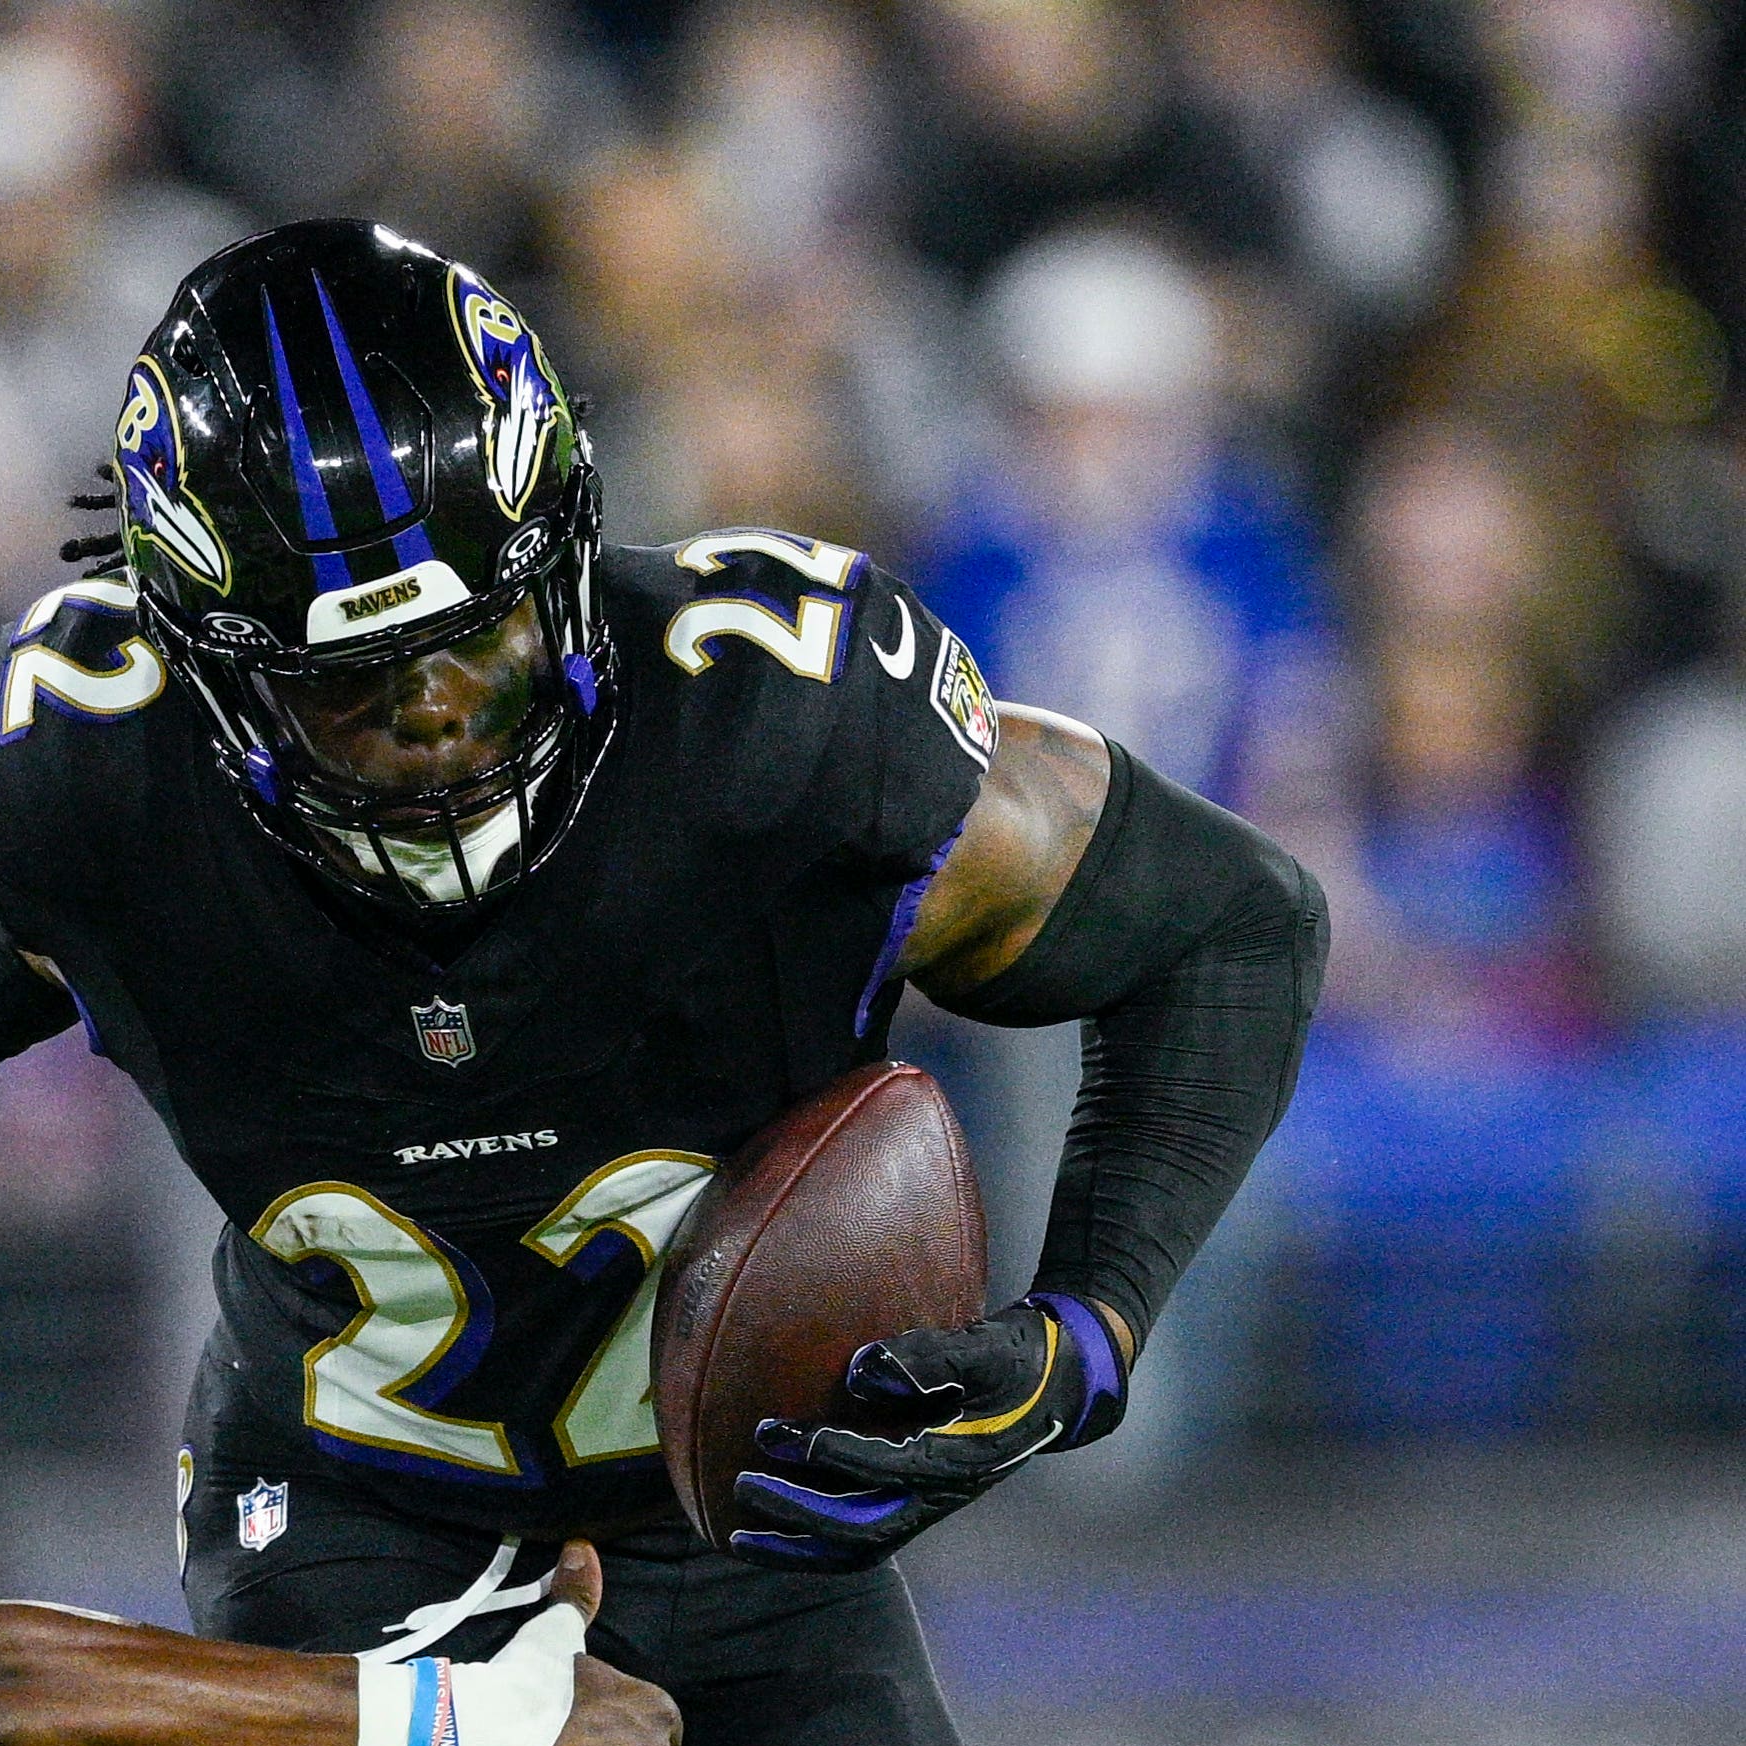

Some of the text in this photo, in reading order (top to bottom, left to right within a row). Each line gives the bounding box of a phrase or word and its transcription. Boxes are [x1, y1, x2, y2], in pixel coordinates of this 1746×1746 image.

[502, 532, 549, 580] OAKLEY
[339, 577, 422, 622] RAVENS
[663, 527, 869, 685] 22
[209, 631, 268, 646] OAKLEY
[425, 1031, 468, 1057] NFL
[393, 1129, 559, 1165] RAVENS
[249, 1149, 721, 1488] 22
